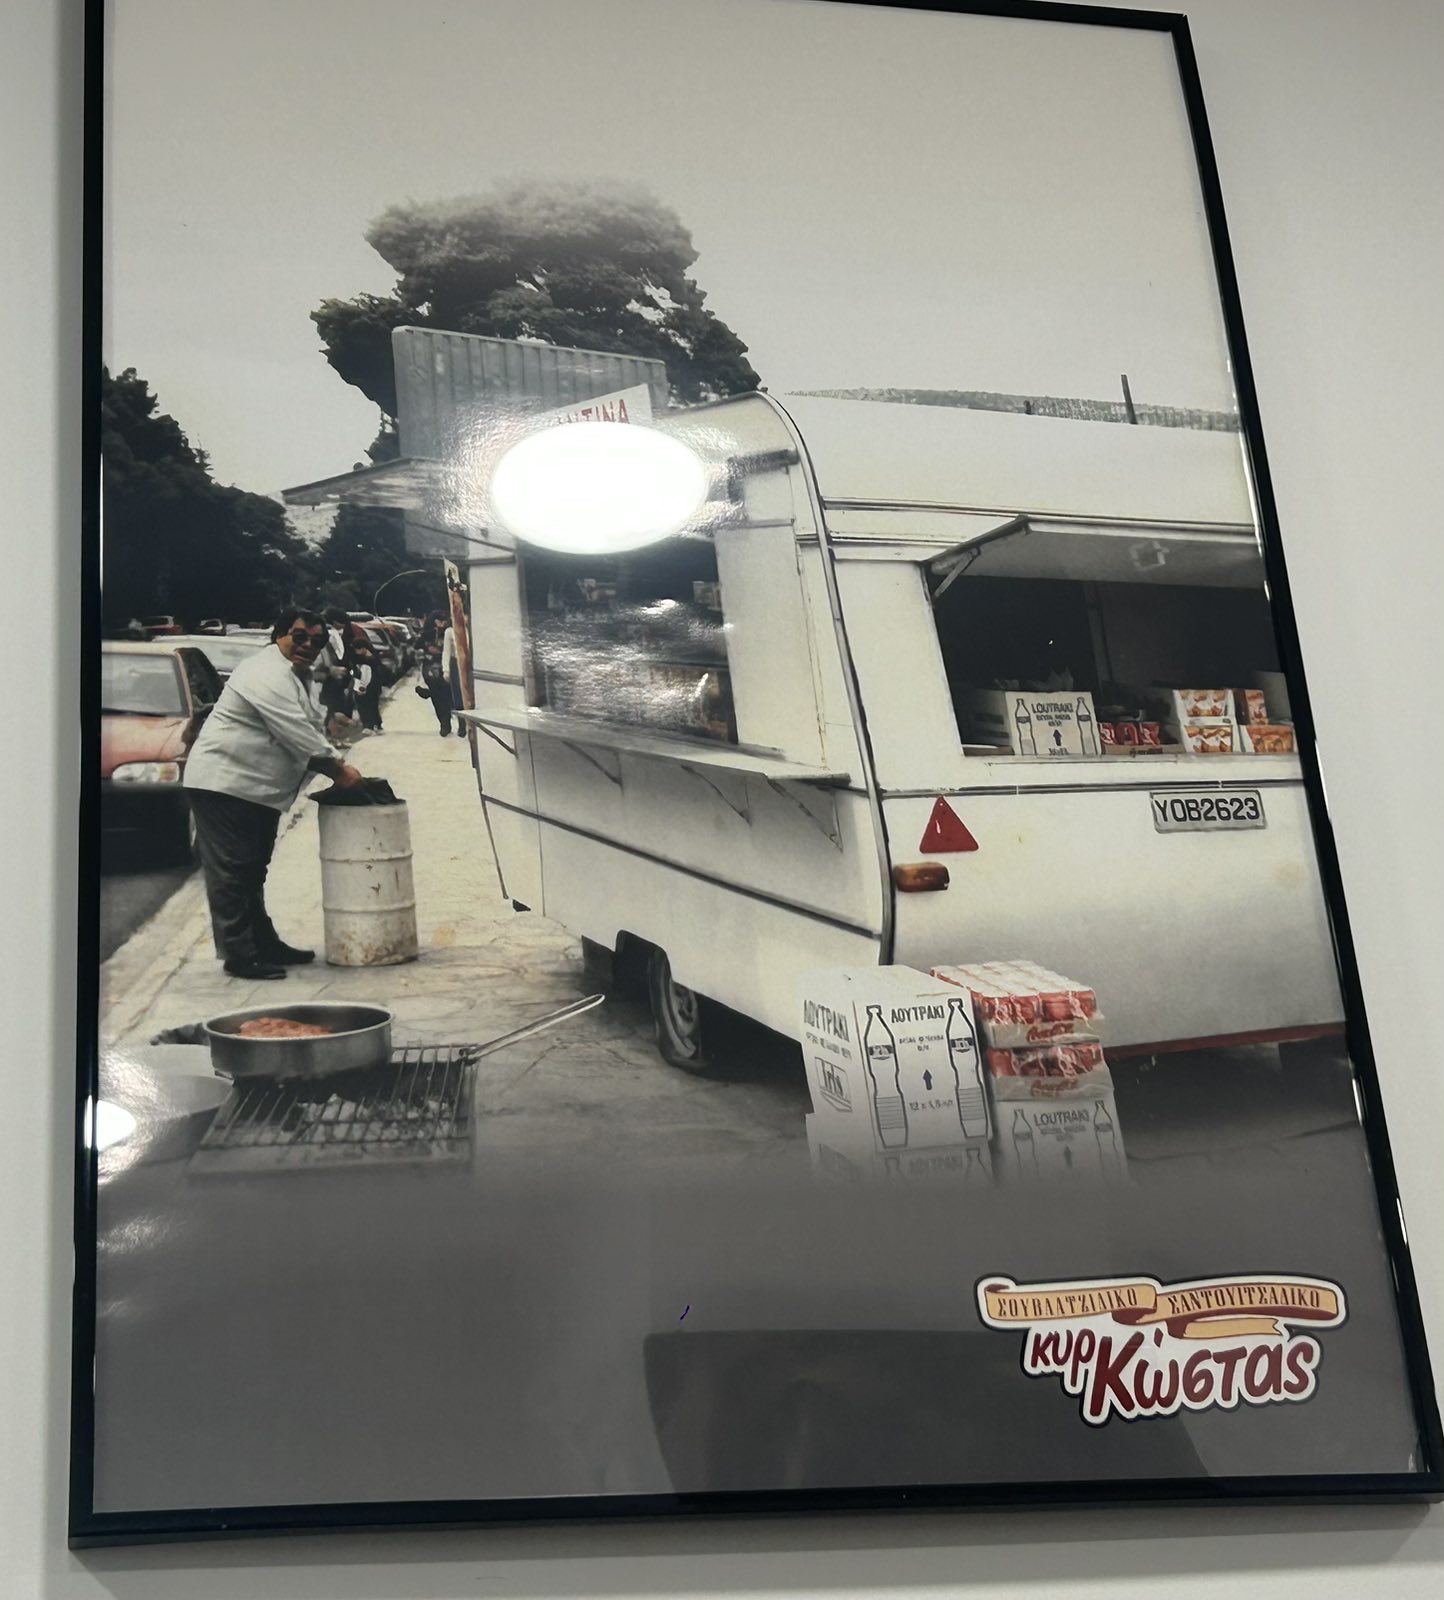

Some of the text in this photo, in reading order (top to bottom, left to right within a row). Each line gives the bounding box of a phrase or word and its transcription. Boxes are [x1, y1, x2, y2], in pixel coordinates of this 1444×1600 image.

[1154, 797, 1260, 822] YOB2623
[891, 1004, 945, 1023] ΛΟΥΤΡΑΚΙ
[1033, 1108, 1090, 1127] LOUTRAKI
